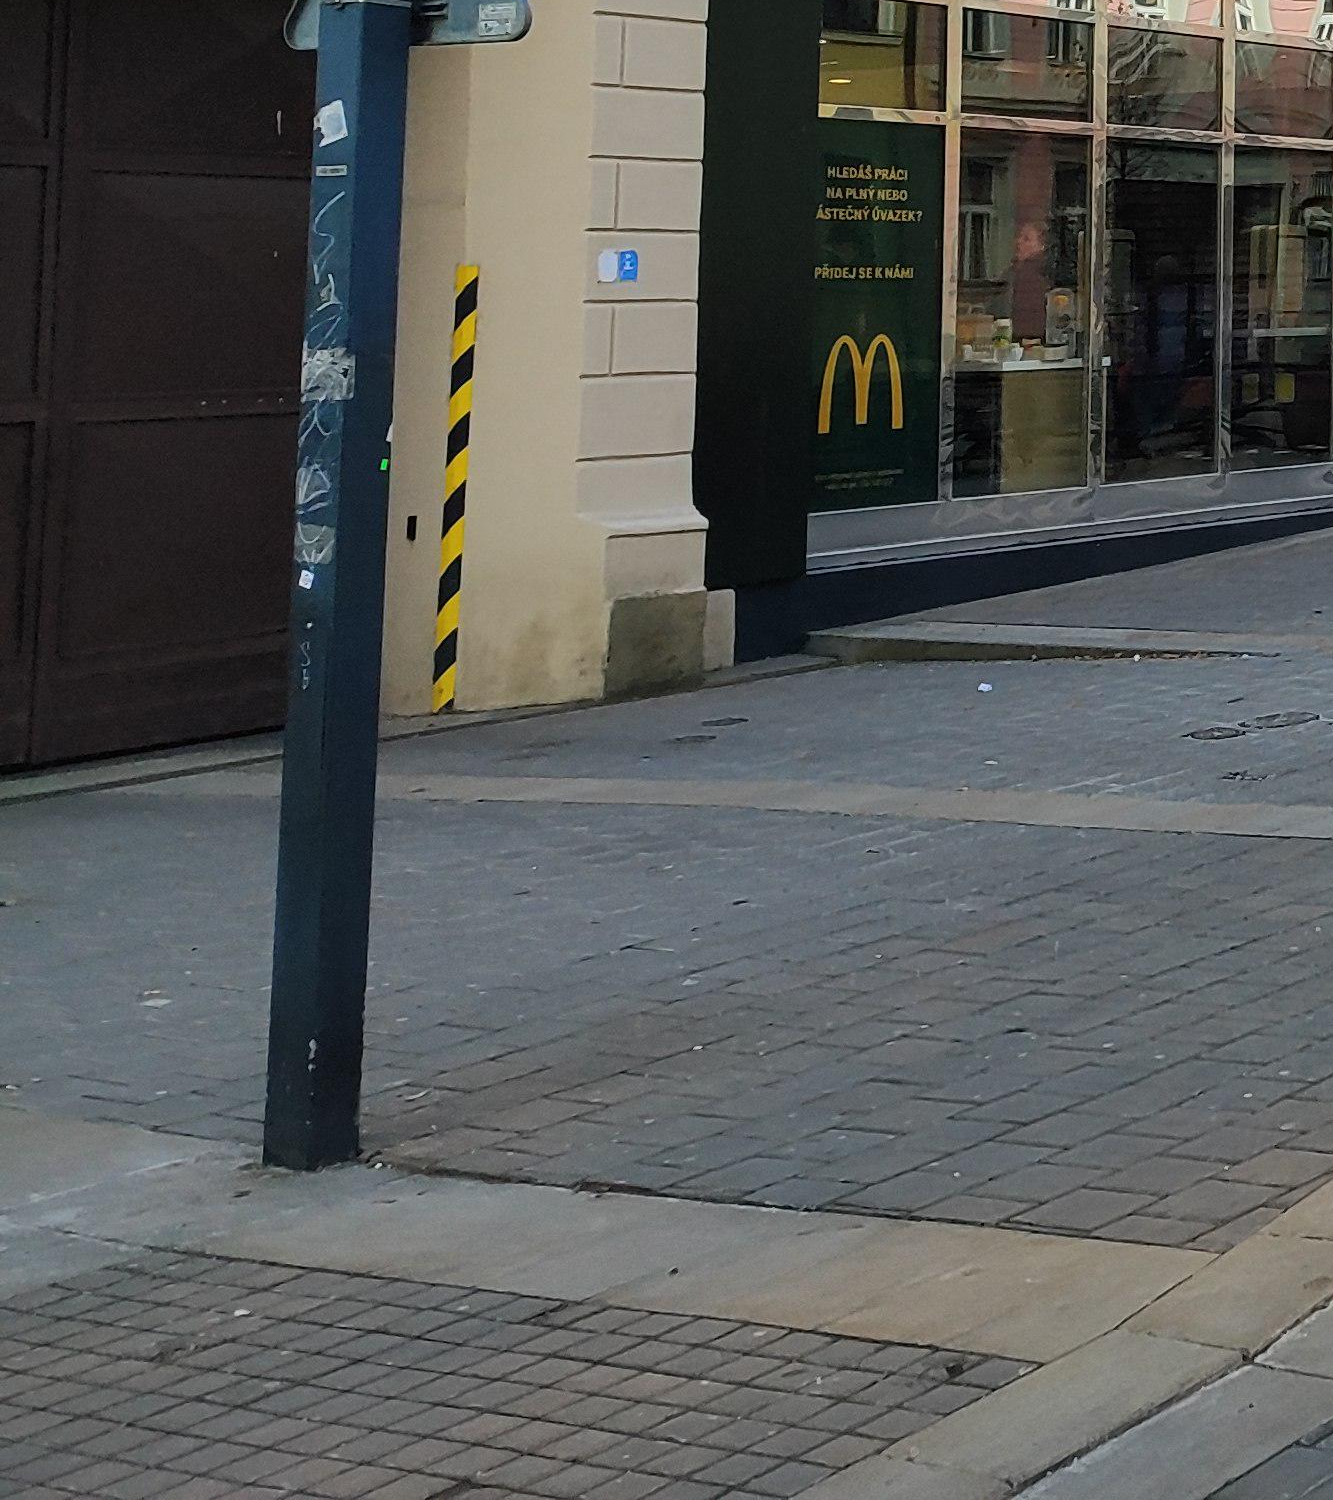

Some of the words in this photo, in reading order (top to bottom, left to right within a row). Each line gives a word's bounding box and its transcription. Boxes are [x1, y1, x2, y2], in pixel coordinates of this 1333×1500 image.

[827, 164, 873, 180] HLEDÁŠ
[874, 166, 909, 180] PRÁCI
[826, 186, 843, 199] NA
[845, 185, 876, 200] PLNÝ
[877, 189, 908, 201] NEBO
[815, 204, 871, 220] ÁSTEČNÝ
[814, 263, 856, 280] PŘIDEJ
[858, 266, 873, 279] SE
[874, 267, 883, 279] K
[884, 264, 914, 279] NÁMI
